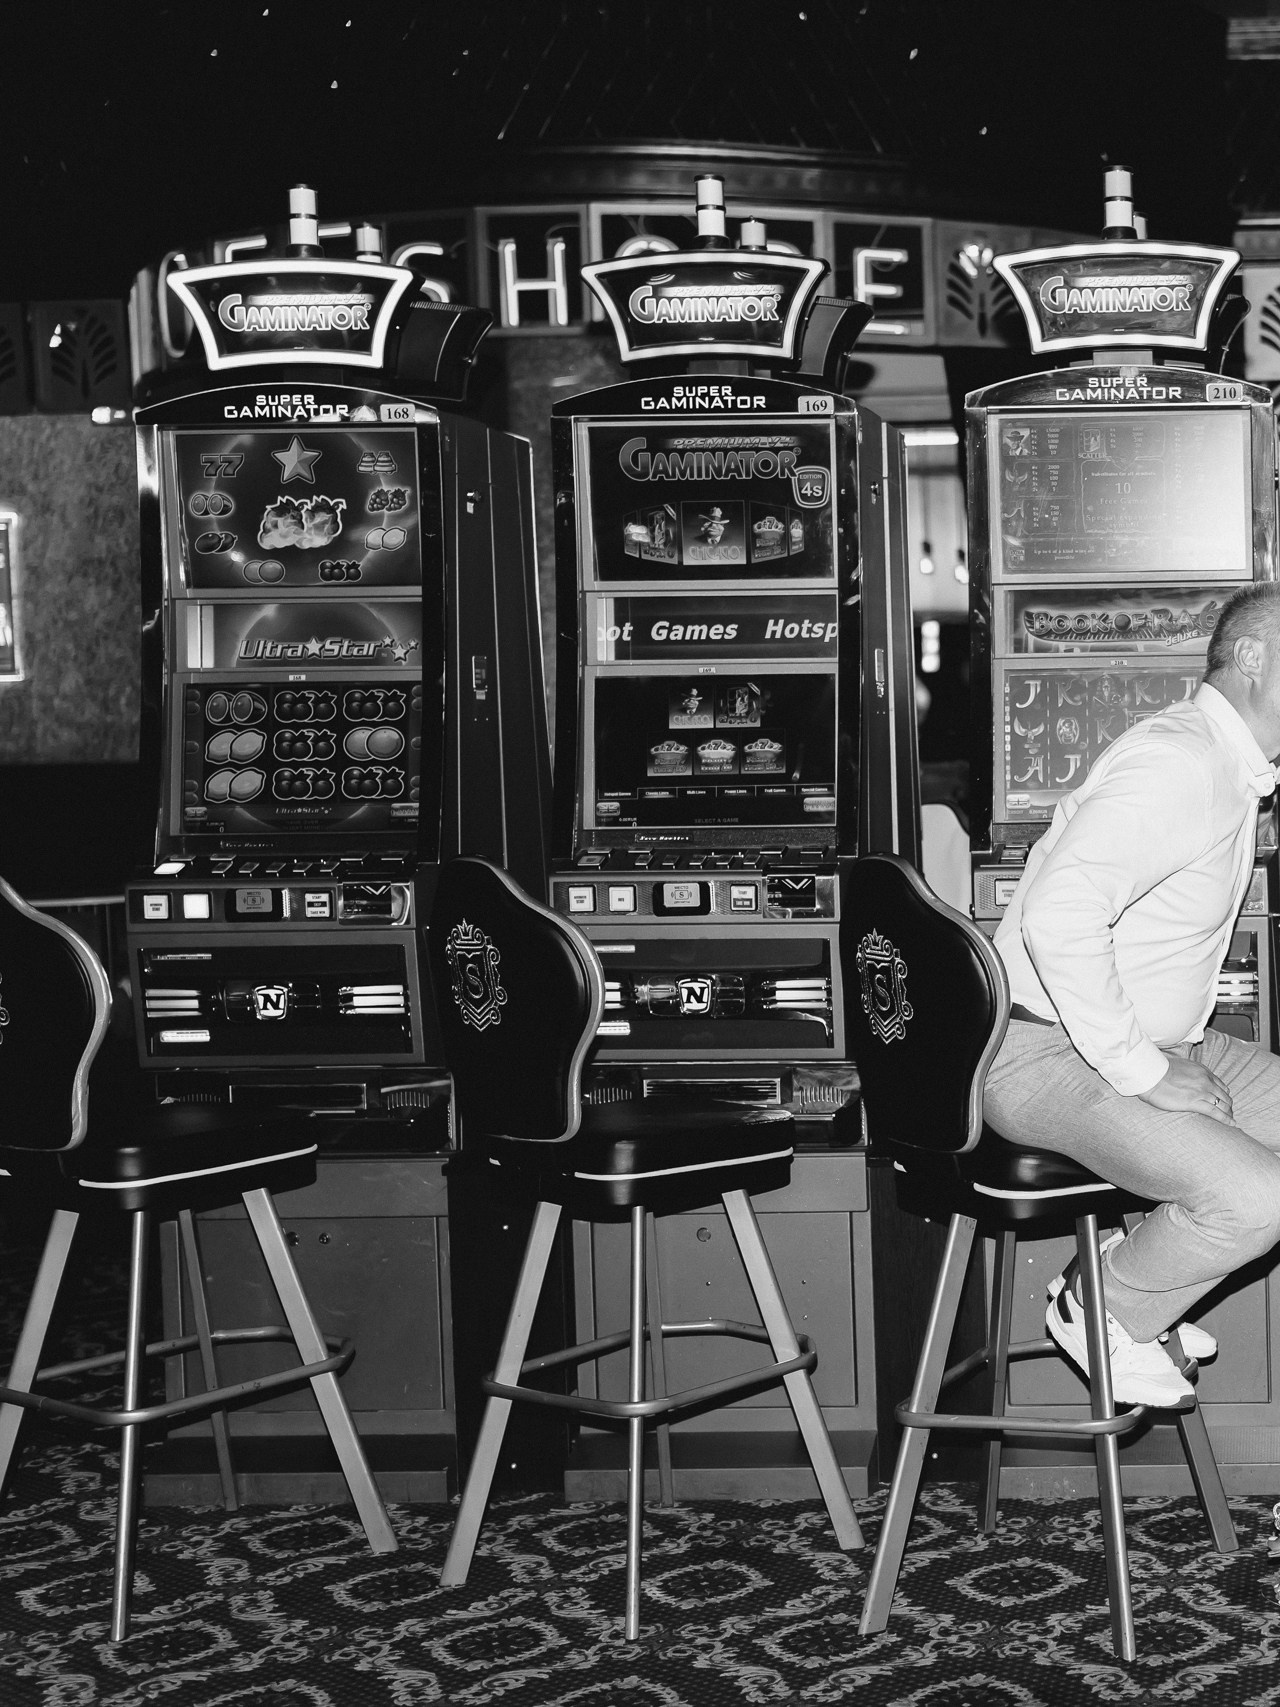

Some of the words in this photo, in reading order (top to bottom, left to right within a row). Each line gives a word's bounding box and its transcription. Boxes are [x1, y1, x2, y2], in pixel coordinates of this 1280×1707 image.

[1088, 377, 1148, 388] SUPER
[673, 386, 732, 397] SUPER
[1056, 387, 1182, 401] GAMINATOR
[1213, 386, 1237, 400] 210
[255, 394, 315, 406] SUPER
[641, 396, 766, 410] GAMINATOR
[804, 398, 828, 413] 169
[224, 405, 349, 419] GAMINATOR
[385, 406, 410, 420] 168
[619, 437, 799, 482] GAMINATOR
[801, 482, 823, 497] 4s
[1115, 482, 1131, 494] 10
[1033, 611, 1110, 635] BOOK
[1150, 608, 1196, 635] RA
[651, 621, 738, 642] Games
[1165, 629, 1199, 646] deluxe
[262, 993, 284, 1011] N
[685, 986, 706, 1004] N
